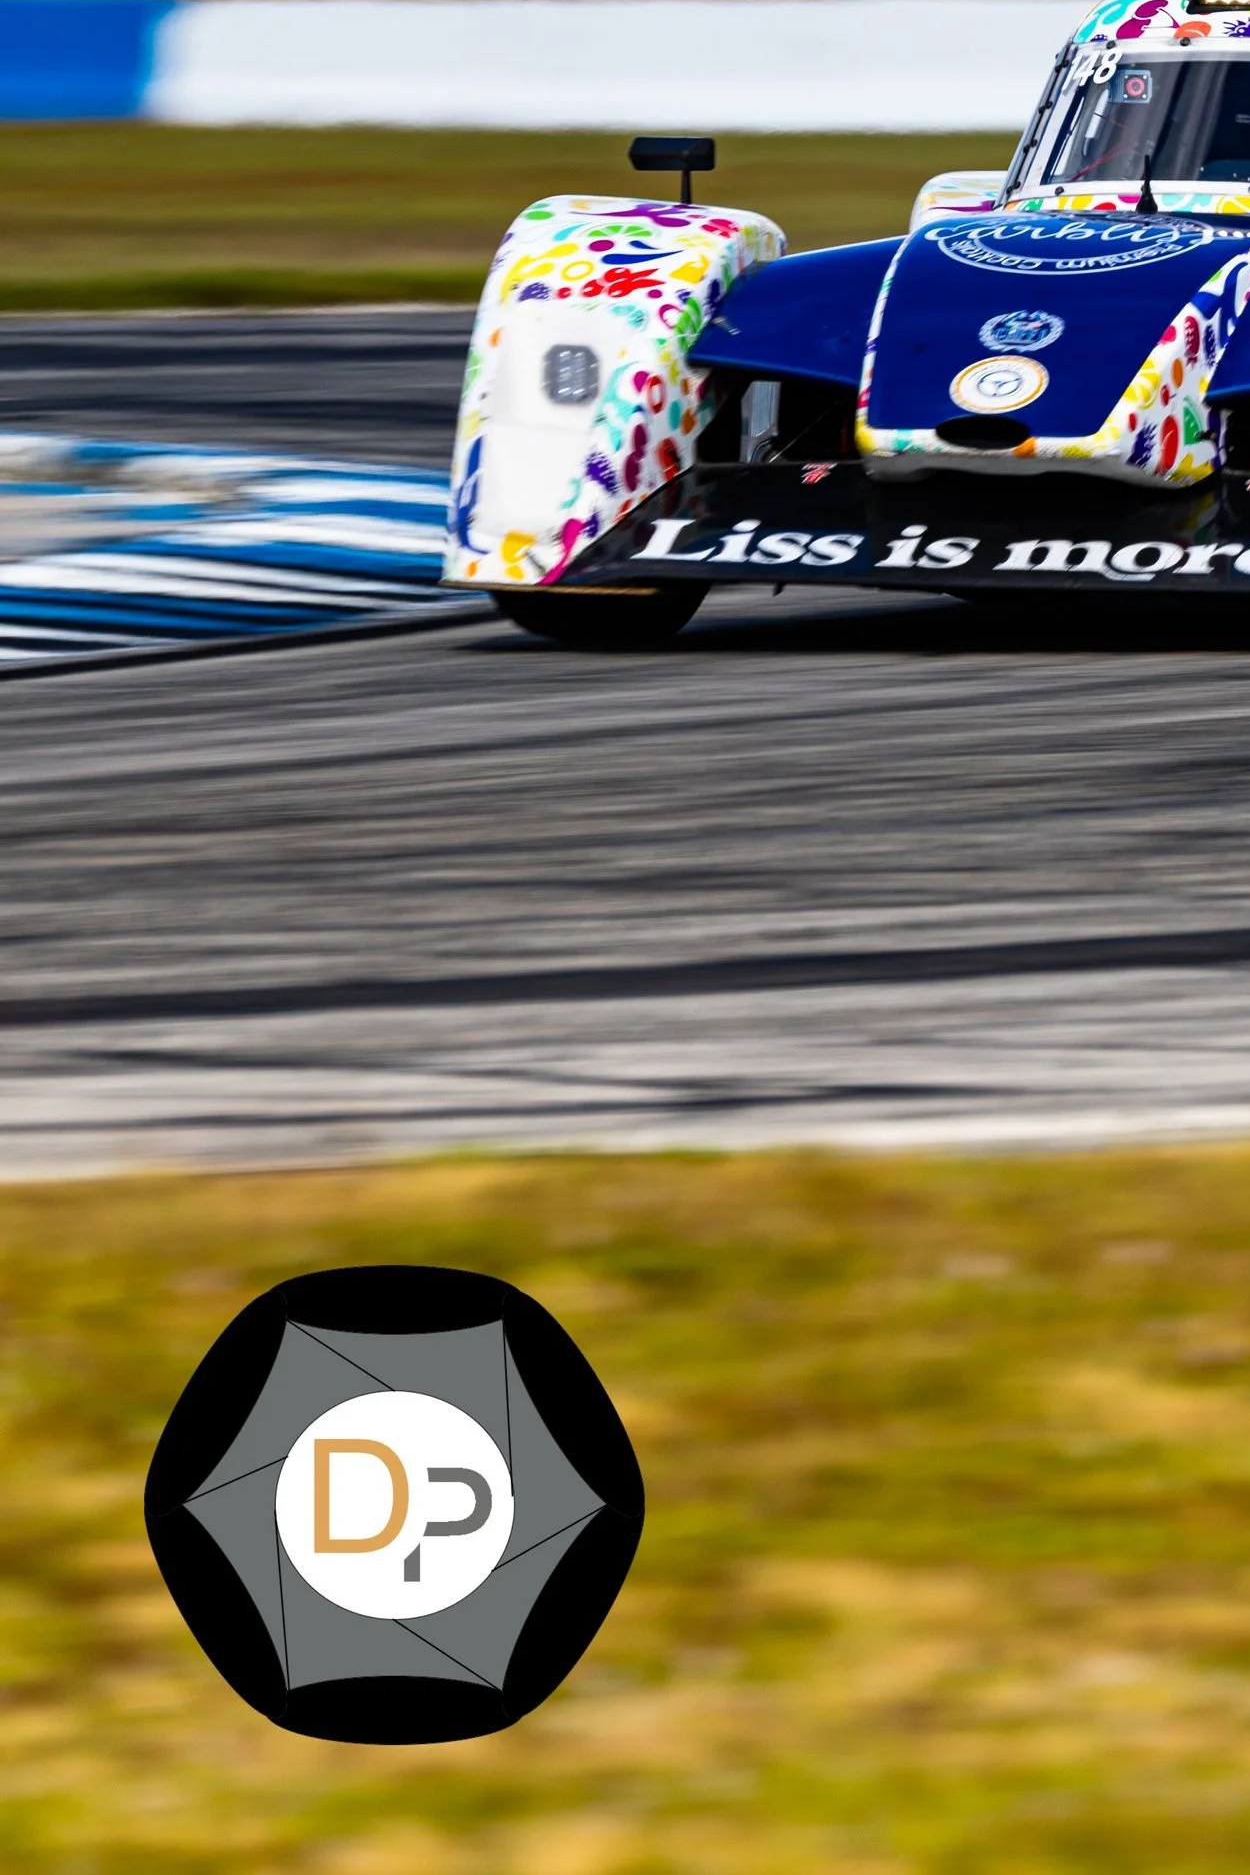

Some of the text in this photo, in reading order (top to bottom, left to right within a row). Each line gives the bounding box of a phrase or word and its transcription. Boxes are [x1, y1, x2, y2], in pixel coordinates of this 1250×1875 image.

[1061, 47, 1123, 87] 148
[630, 519, 864, 566] Liss
[874, 525, 981, 570] is
